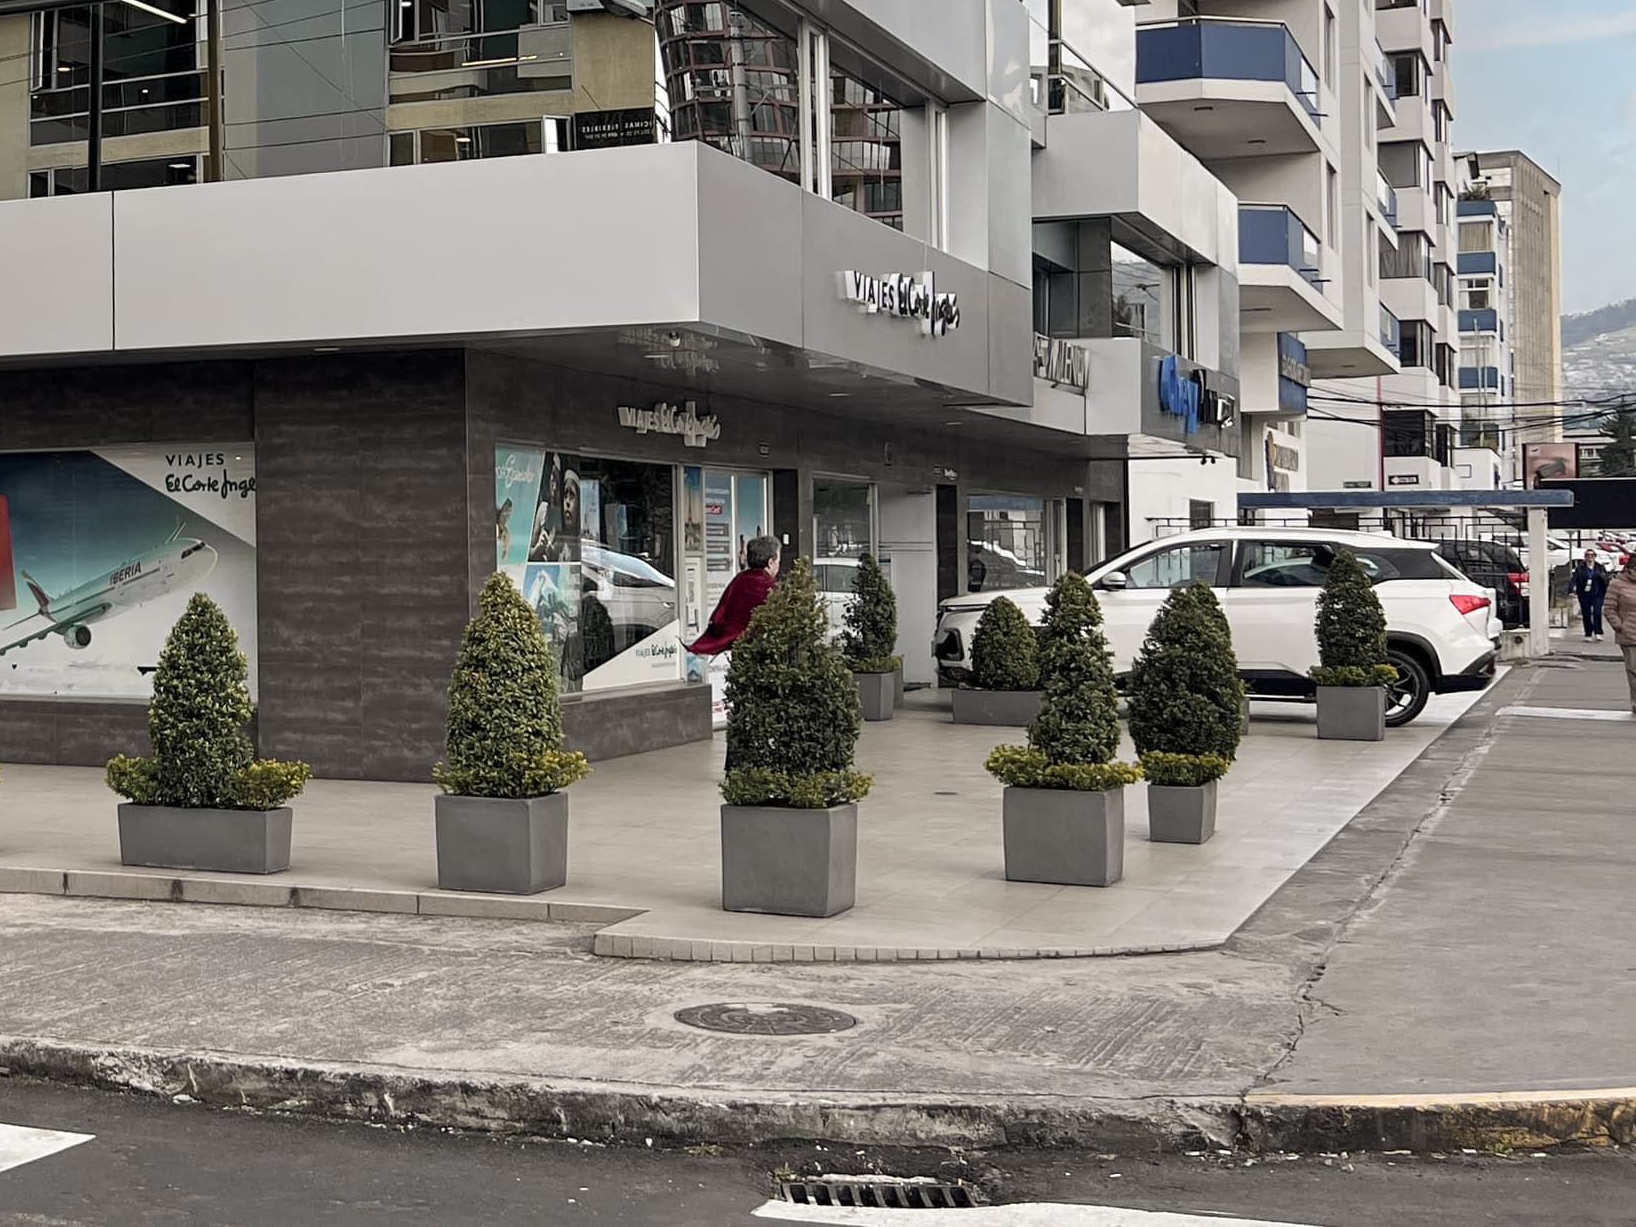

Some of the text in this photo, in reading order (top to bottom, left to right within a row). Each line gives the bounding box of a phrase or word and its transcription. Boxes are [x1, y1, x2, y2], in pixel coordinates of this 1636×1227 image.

[848, 270, 895, 313] VIAJES
[165, 453, 224, 469] VIAJES
[165, 474, 181, 493] El
[182, 474, 219, 493] Corte
[109, 561, 142, 586] IBERIA
